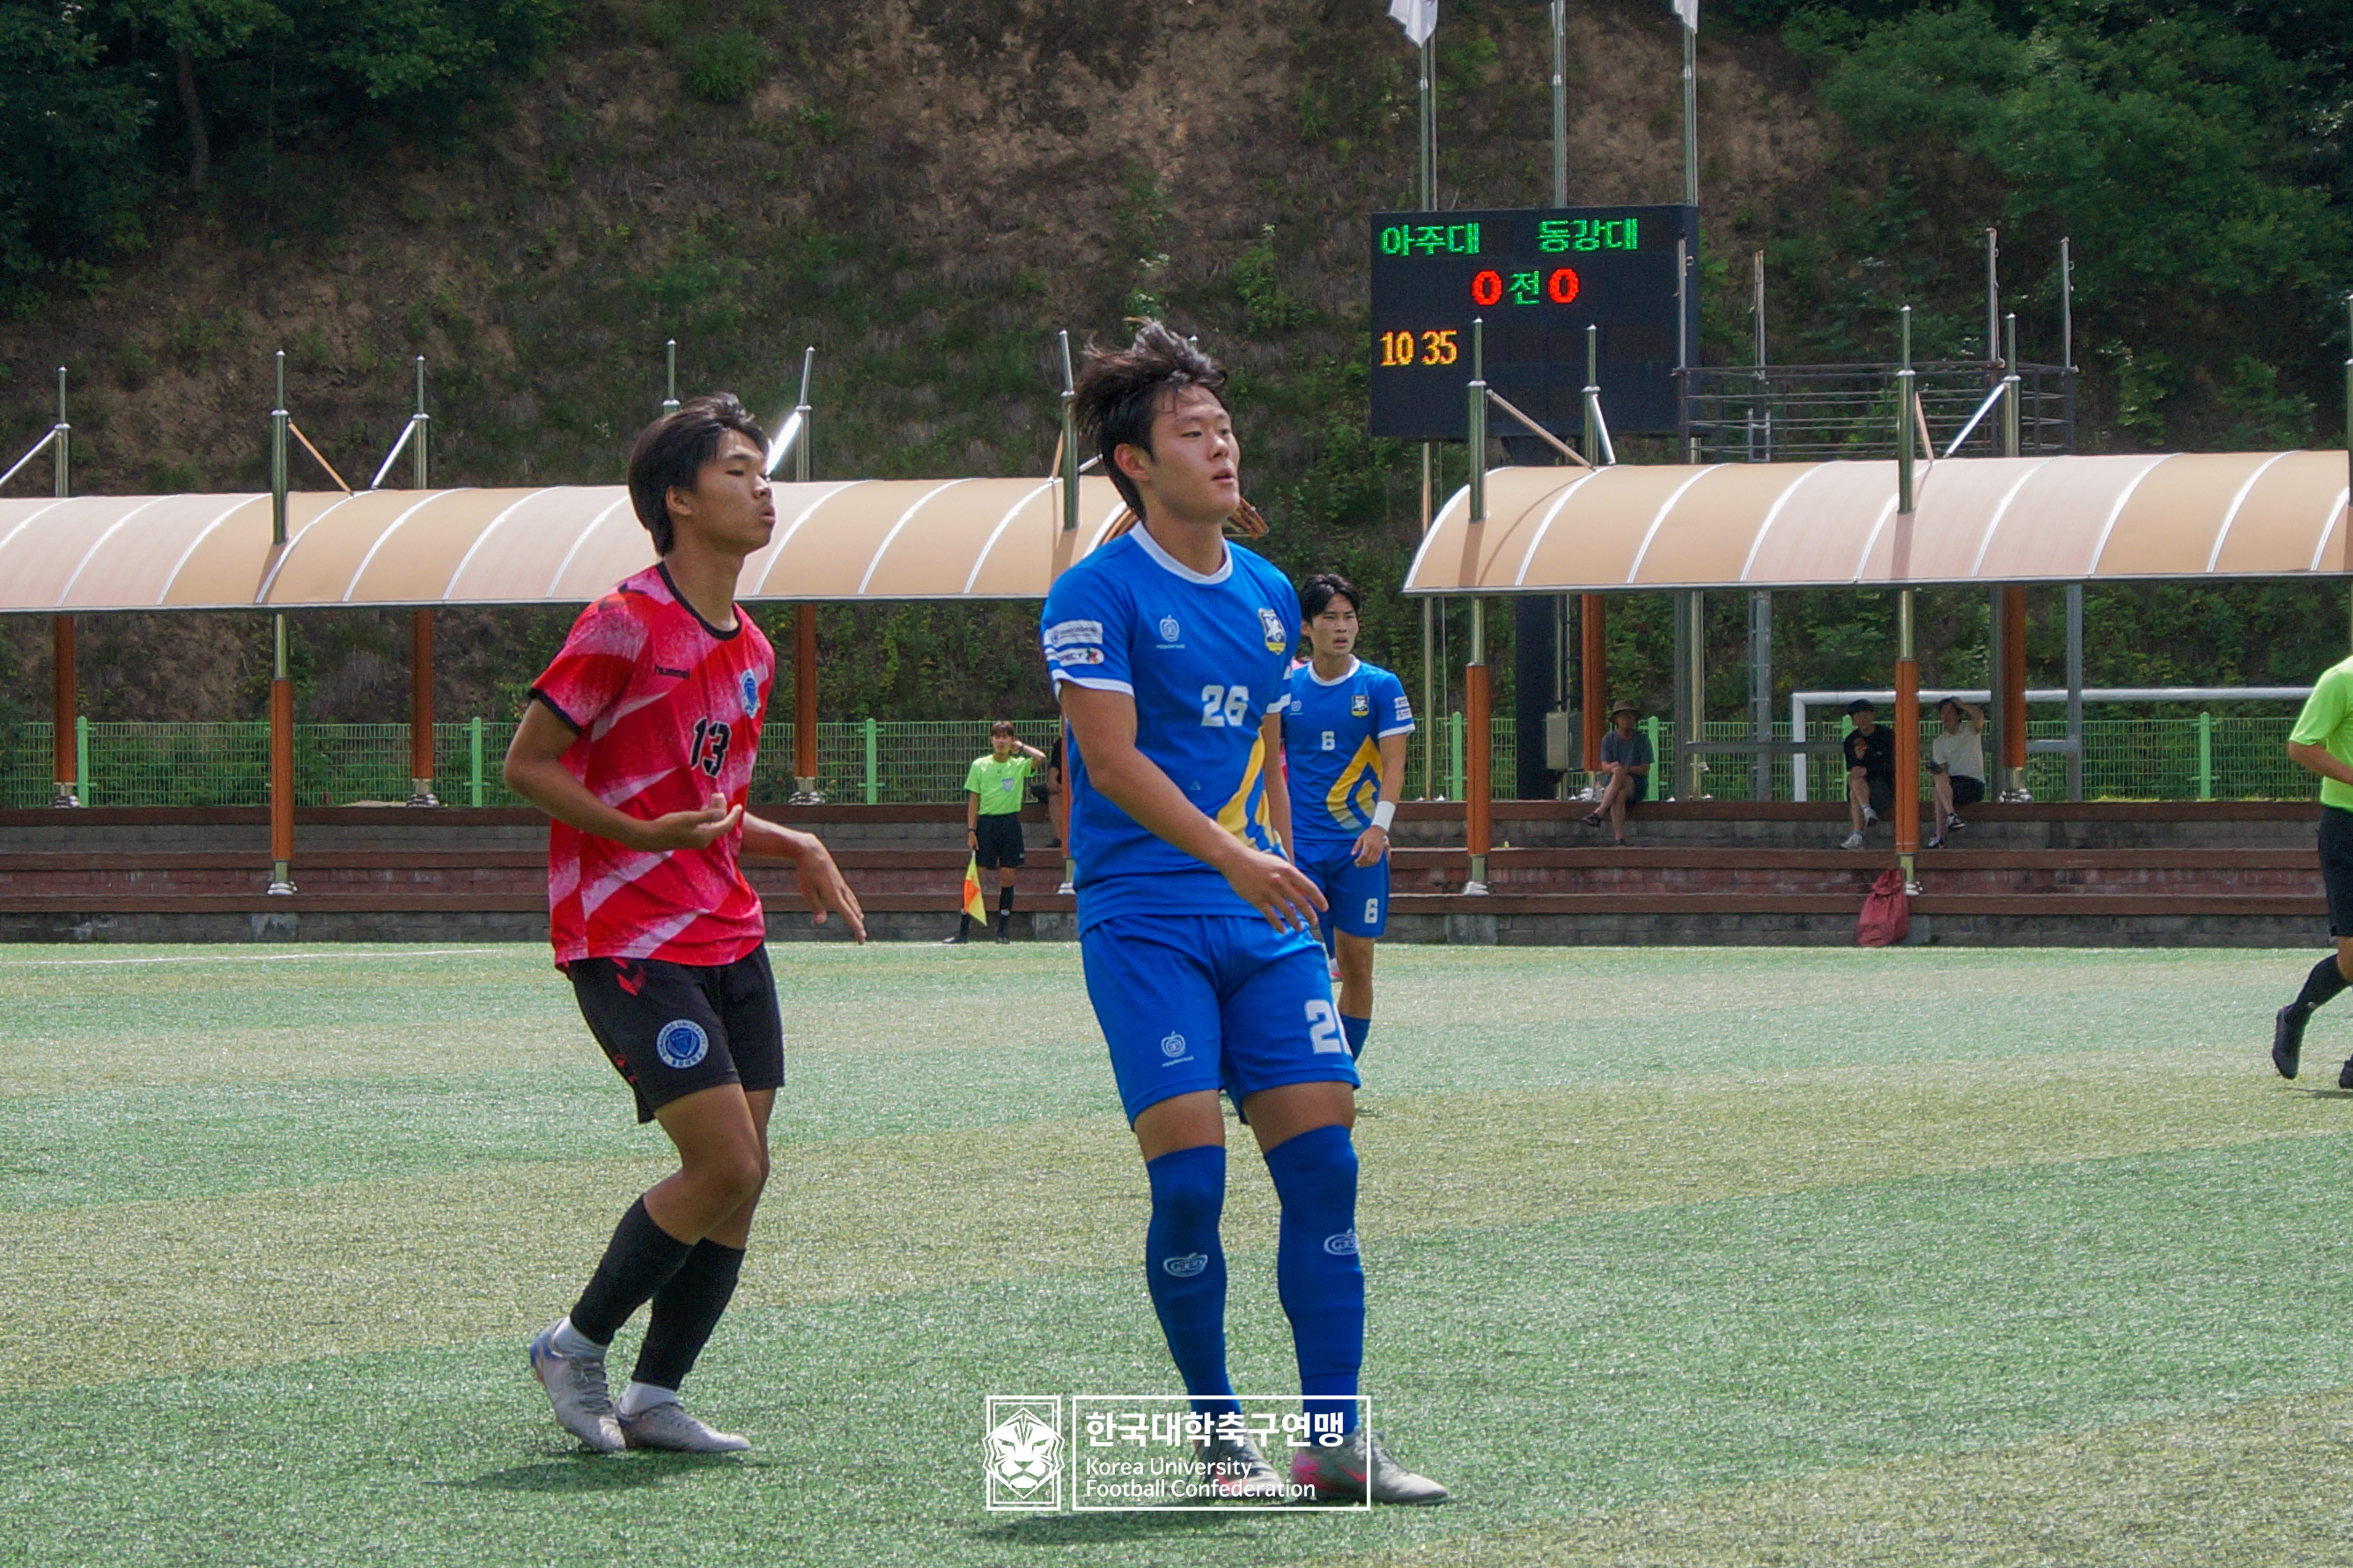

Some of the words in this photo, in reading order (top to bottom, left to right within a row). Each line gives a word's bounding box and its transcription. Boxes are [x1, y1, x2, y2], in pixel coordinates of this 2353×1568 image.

[1379, 222, 1480, 256] 아주대
[1537, 217, 1638, 252] 동강대
[1472, 269, 1502, 306] 0
[1508, 270, 1539, 305] 전
[1548, 268, 1579, 304] 0
[1380, 330, 1414, 365] 10
[1420, 329, 1457, 365] 35
[1201, 684, 1250, 727] 26
[690, 717, 732, 778] 13
[1322, 731, 1335, 750] 6
[1364, 898, 1379, 924] 6
